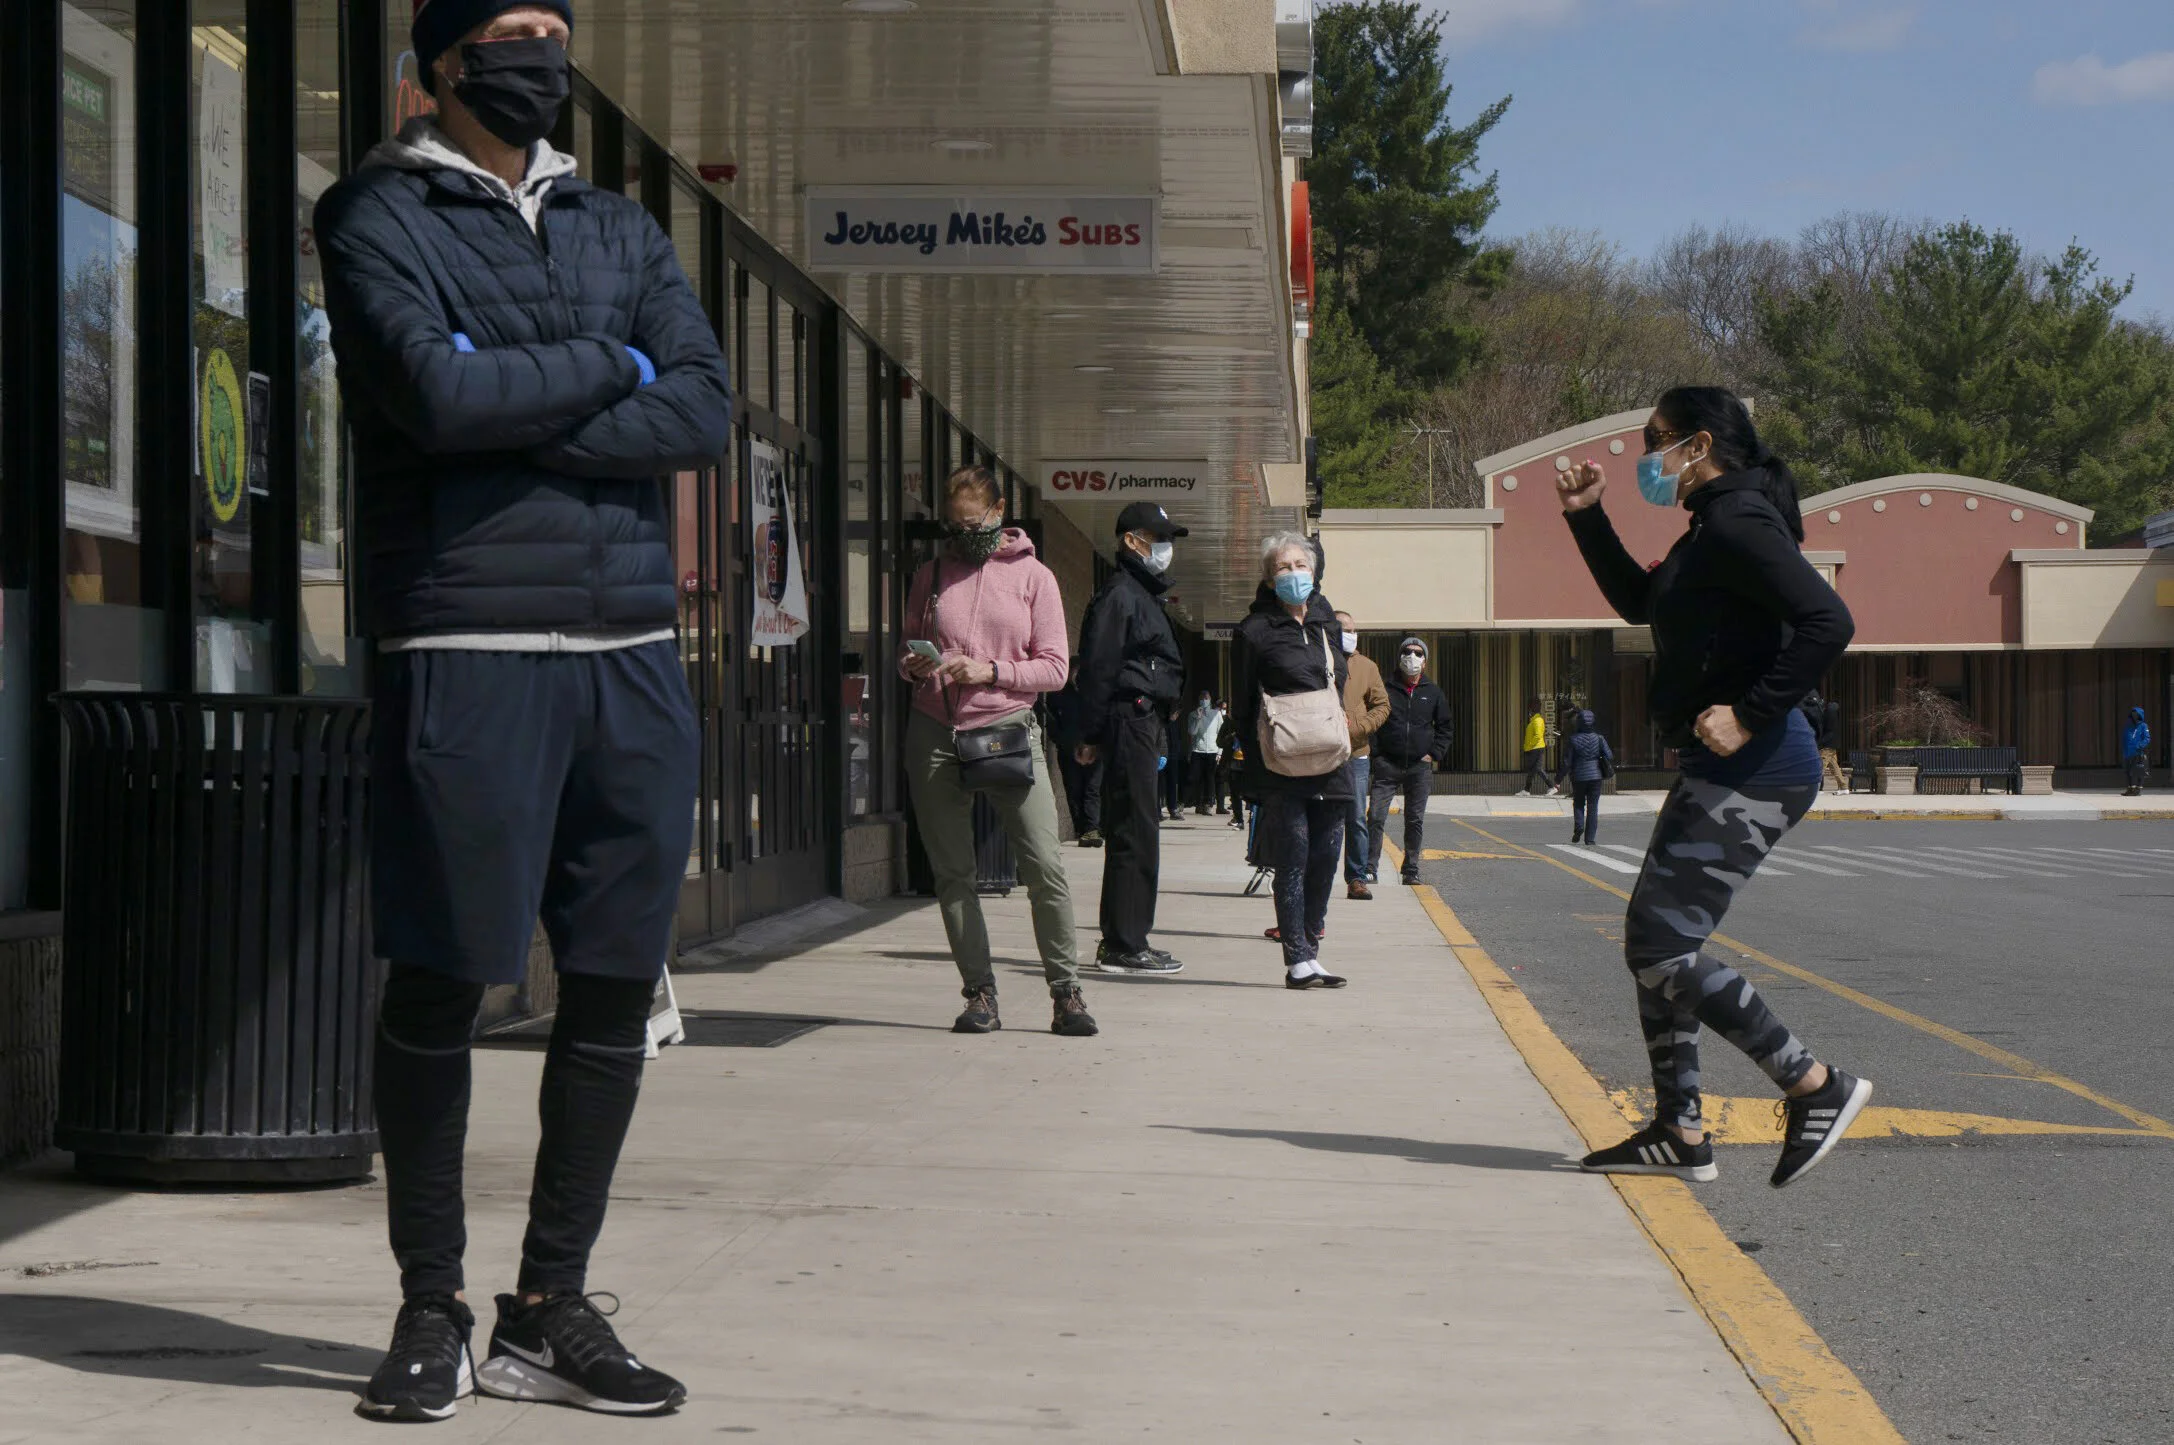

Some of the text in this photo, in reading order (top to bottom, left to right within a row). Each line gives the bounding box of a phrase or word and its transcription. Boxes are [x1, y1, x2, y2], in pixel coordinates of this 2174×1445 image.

[211, 103, 231, 168] WE
[206, 168, 229, 216] ARE
[824, 211, 937, 255] Jersey
[946, 211, 1047, 247] Mike's
